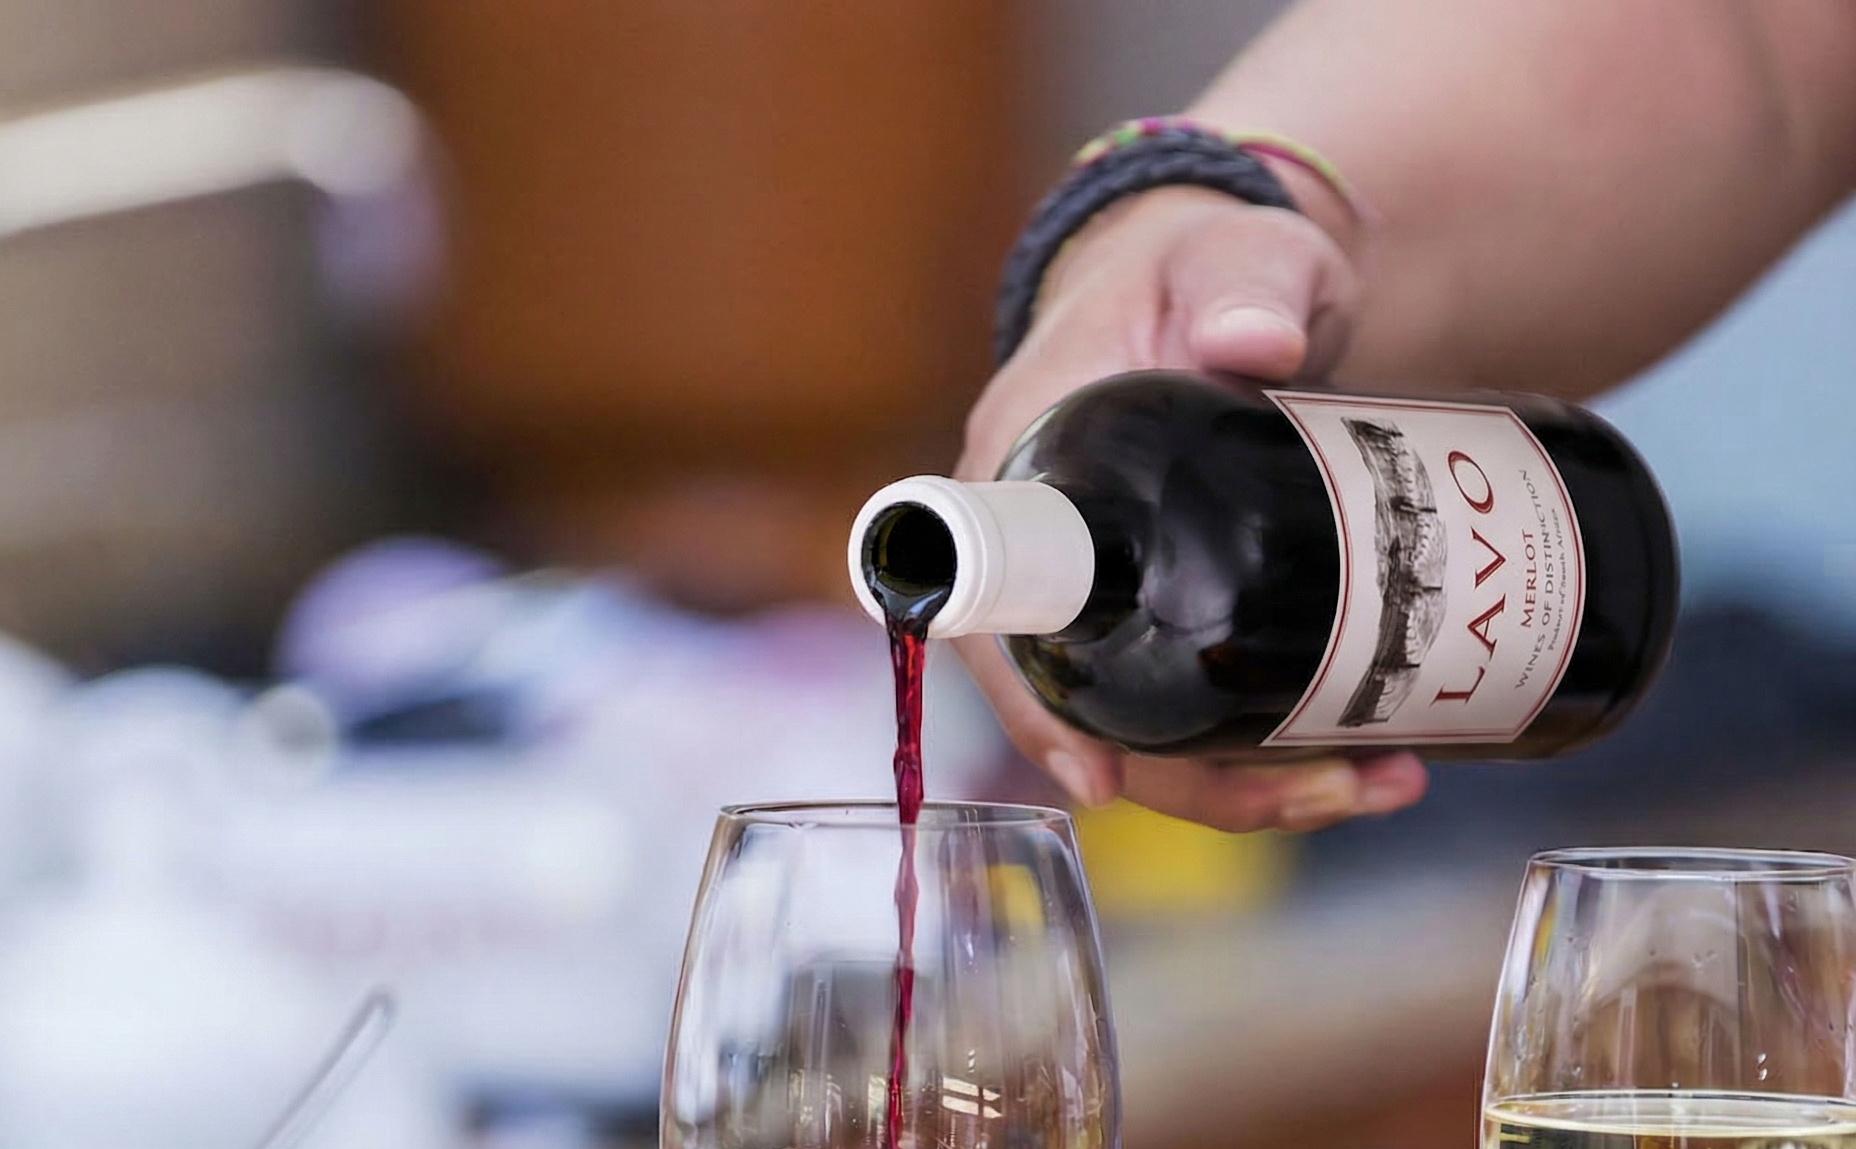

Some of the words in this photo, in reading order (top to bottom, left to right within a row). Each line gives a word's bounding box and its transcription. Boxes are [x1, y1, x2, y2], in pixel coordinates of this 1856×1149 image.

[1431, 451, 1506, 707] LAVO
[1518, 469, 1554, 593] DISTINCTION
[1520, 529, 1537, 628] MERLOT
[1515, 634, 1546, 689] WINES
[1541, 601, 1553, 626] OF
